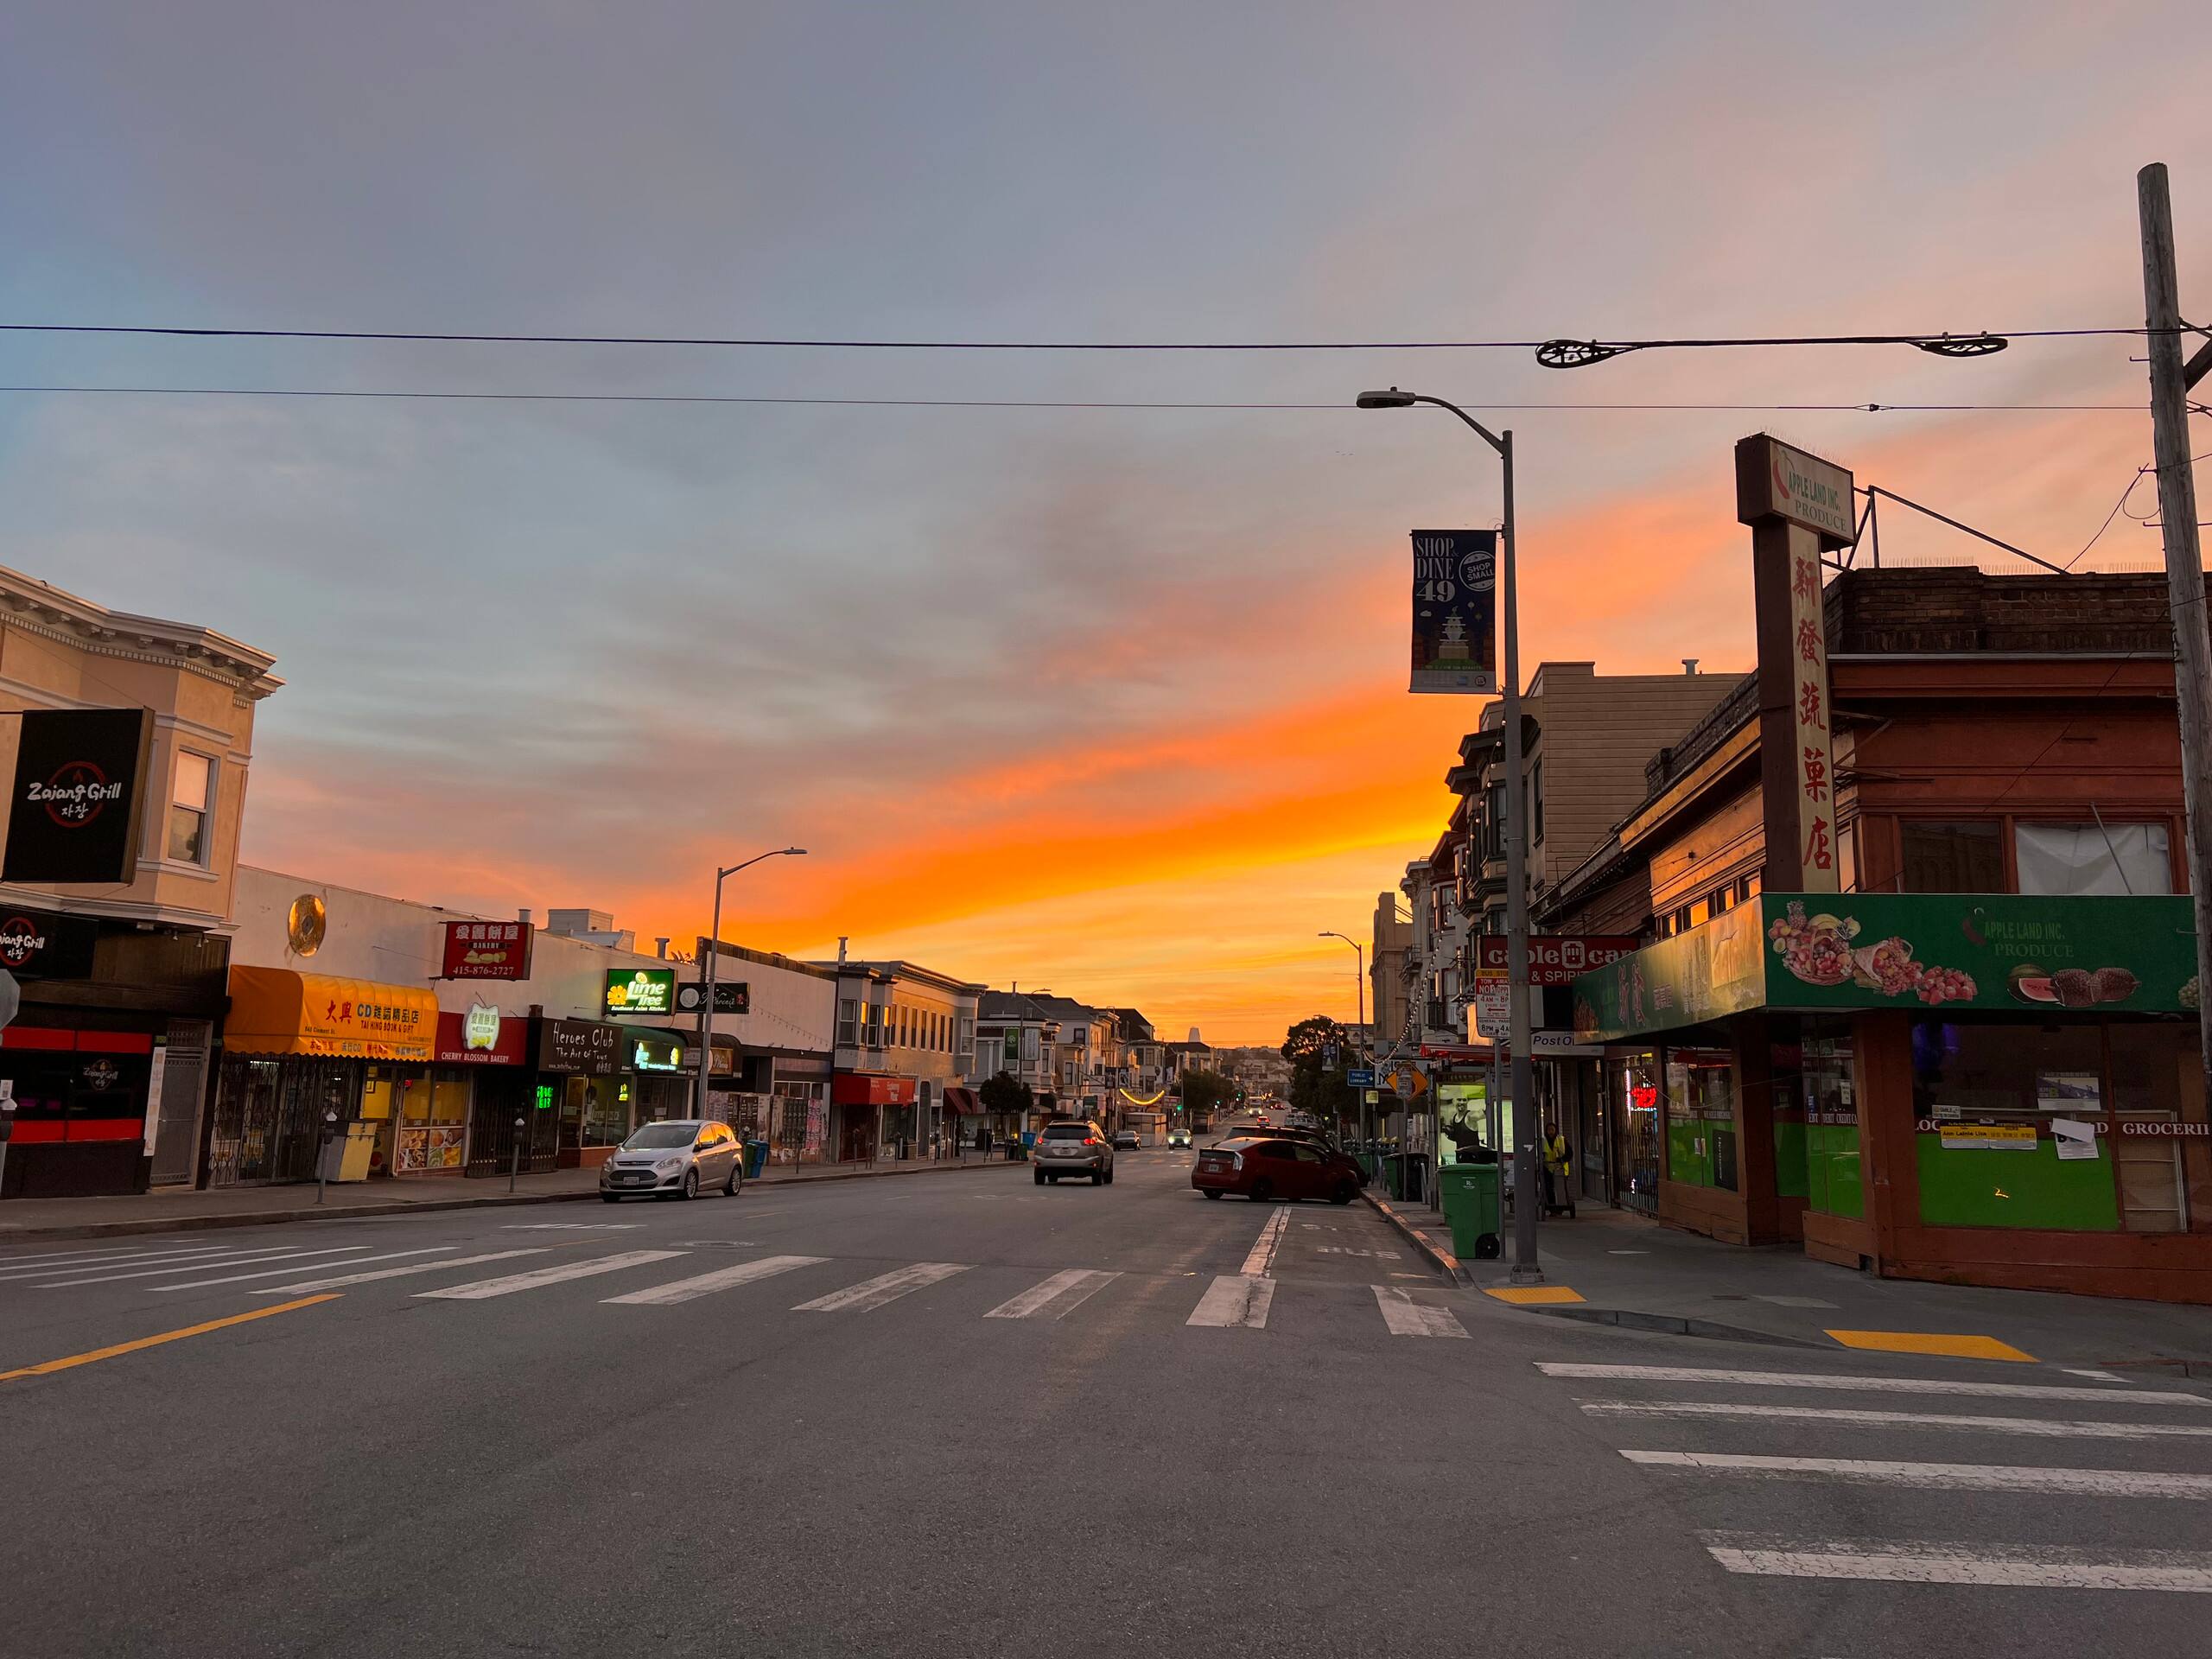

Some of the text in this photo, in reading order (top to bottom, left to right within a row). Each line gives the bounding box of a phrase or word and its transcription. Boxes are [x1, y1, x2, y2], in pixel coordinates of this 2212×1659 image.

[1789, 471, 1840, 512] APPLE LAND INC.
[1796, 499, 1847, 532] PRODUCE
[1416, 557, 1454, 580] DINE
[1467, 562, 1491, 574] SHOP
[1467, 569, 1495, 582] SMALL
[1416, 580, 1456, 602] 49
[28, 781, 122, 804] Zajang Grill
[61, 802, 89, 819] 자장
[1984, 920, 2066, 941] APPLE LAND INC.
[23, 935, 45, 949] Grill
[1994, 943, 2075, 958] PRODUCE
[453, 966, 515, 976] 415-876-2727
[1531, 970, 1541, 982] &
[626, 981, 666, 1000] Lime
[637, 995, 663, 1007] Tree
[553, 1022, 613, 1048] Heroes Club
[1533, 1036, 1560, 1046] Post
[441, 1052, 510, 1064] CHERRY BLOSSOM BAKERY
[556, 1046, 569, 1057] The
